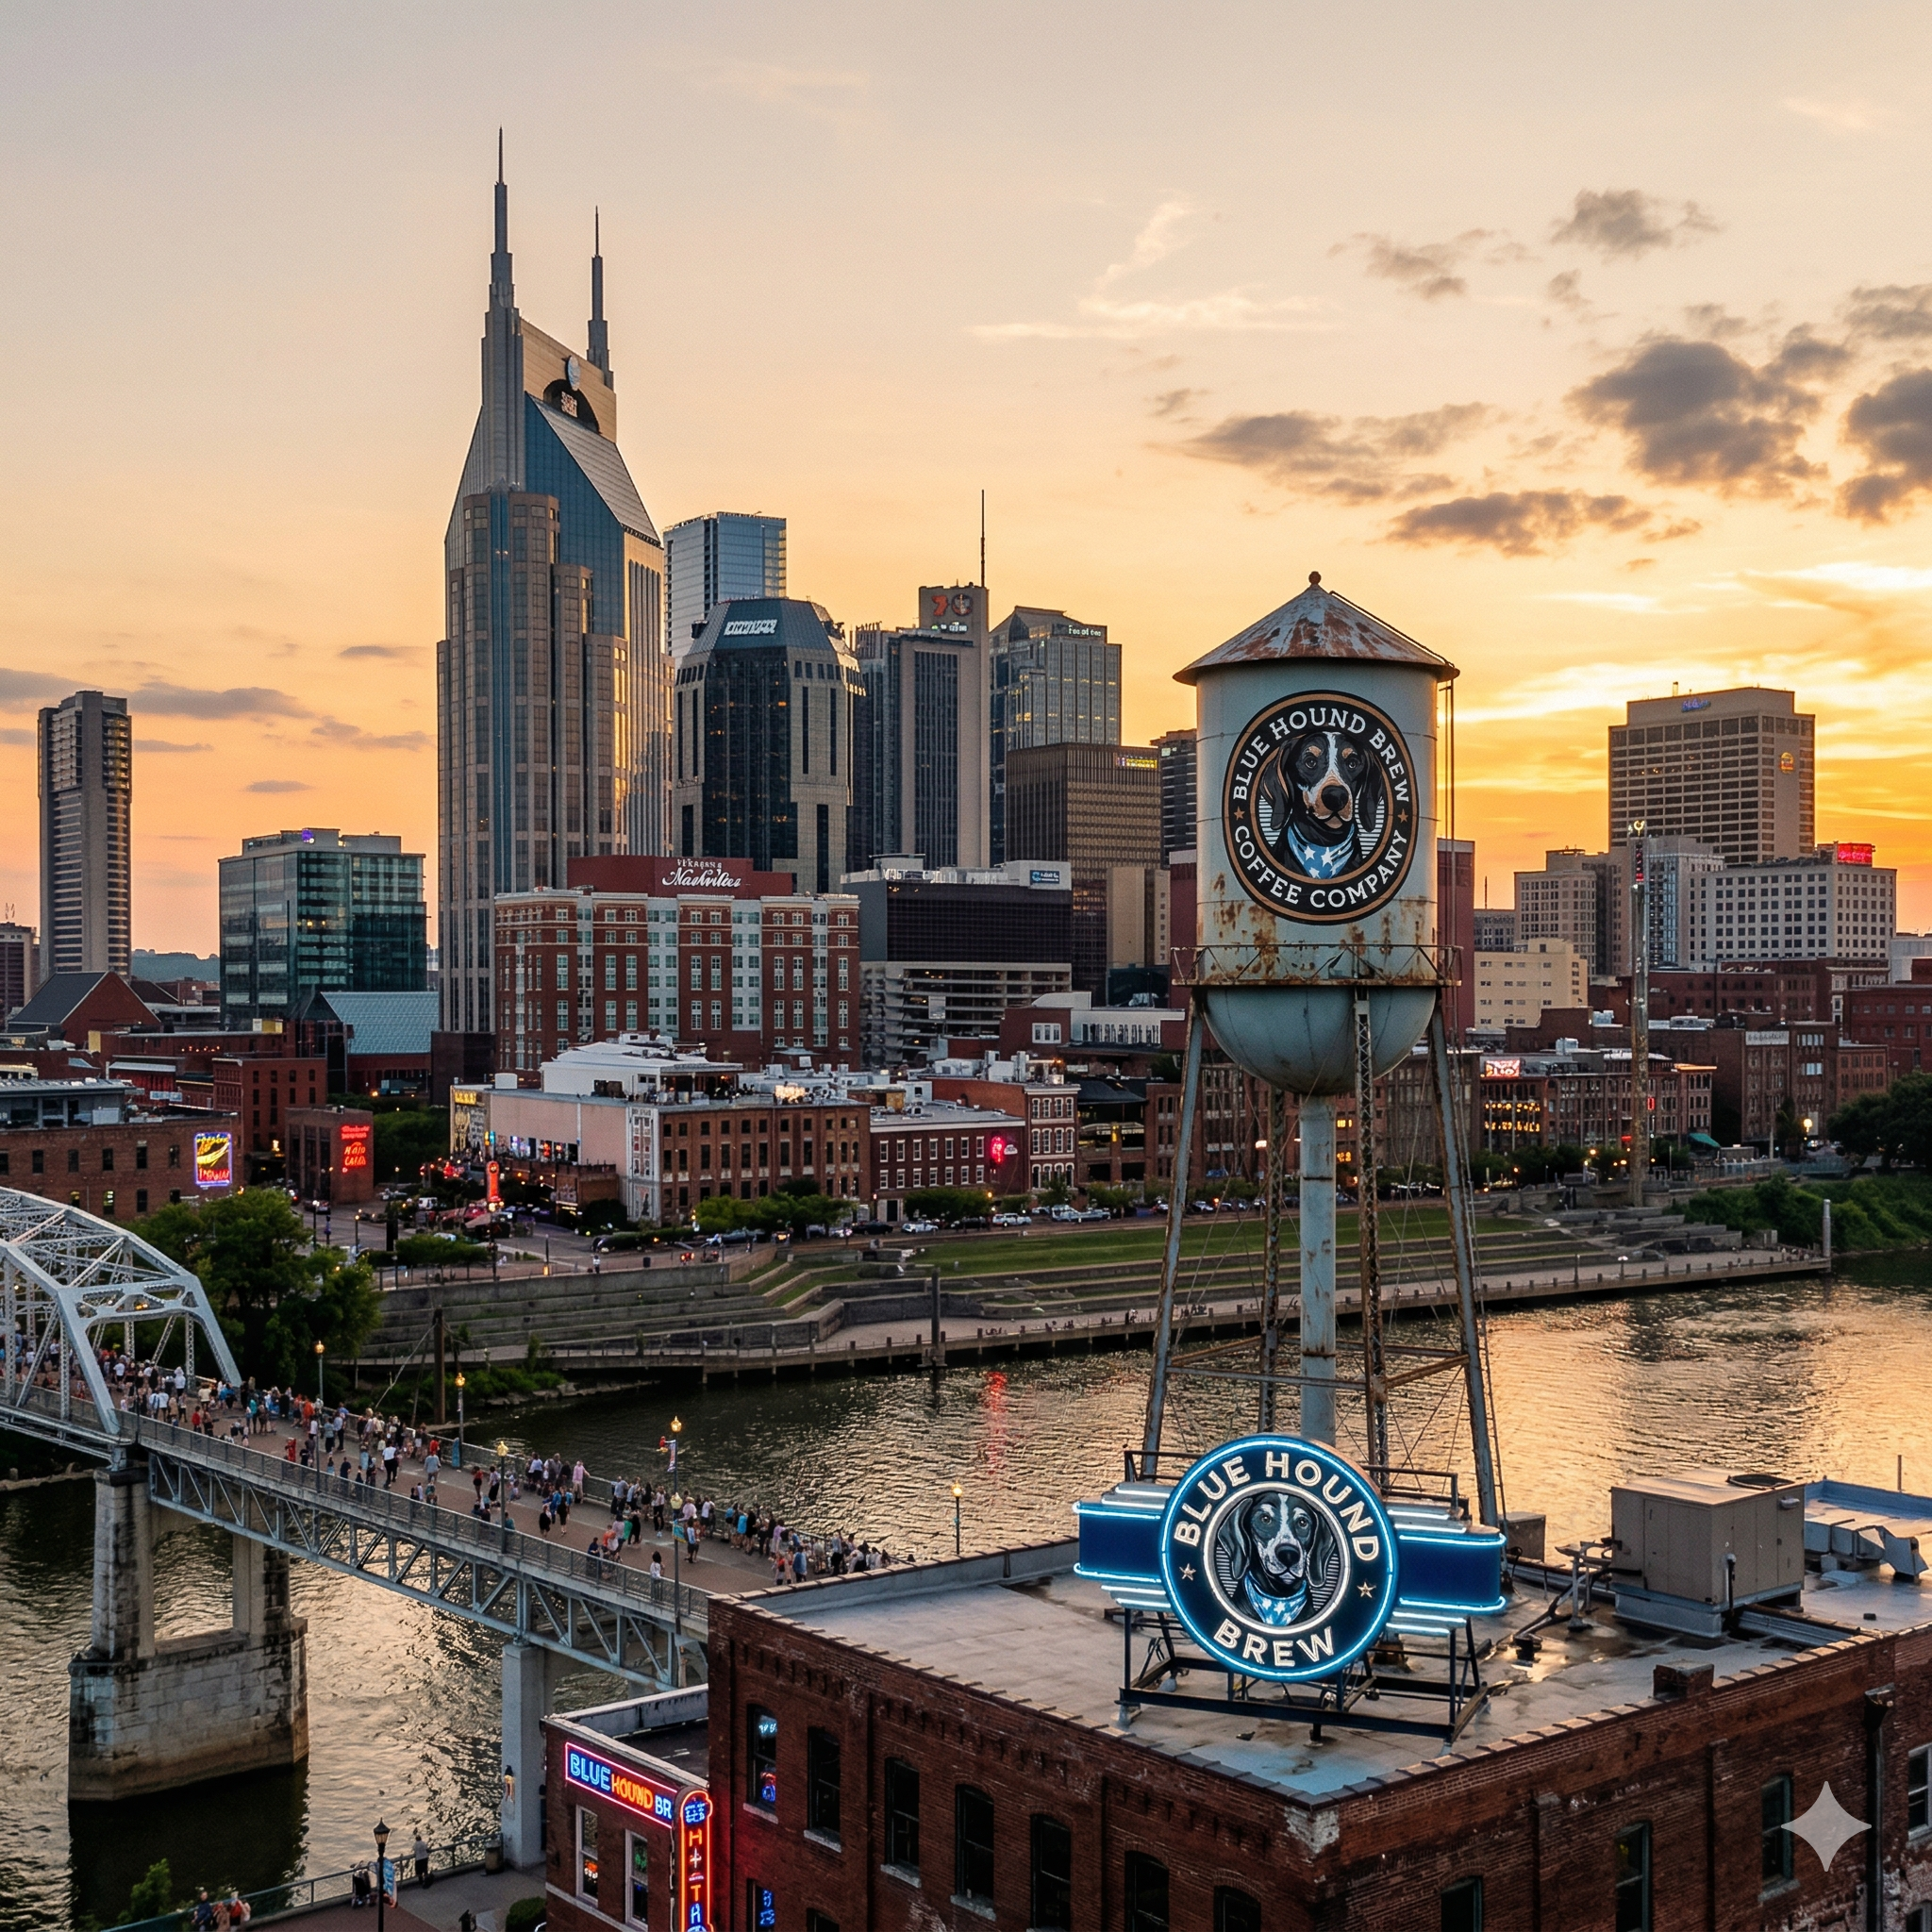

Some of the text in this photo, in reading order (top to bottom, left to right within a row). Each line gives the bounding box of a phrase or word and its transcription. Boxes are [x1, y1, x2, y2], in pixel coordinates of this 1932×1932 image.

[1233, 708, 1409, 803] BLUE HOUND BREW
[1234, 825, 1407, 908] COFFEE COMPANY
[1174, 1451, 1380, 1561] BLUE HOUND
[1213, 1619, 1334, 1668] BREW
[570, 1753, 611, 1791] BLUE
[611, 1774, 654, 1809] HOUND
[655, 1794, 673, 1820] BR
